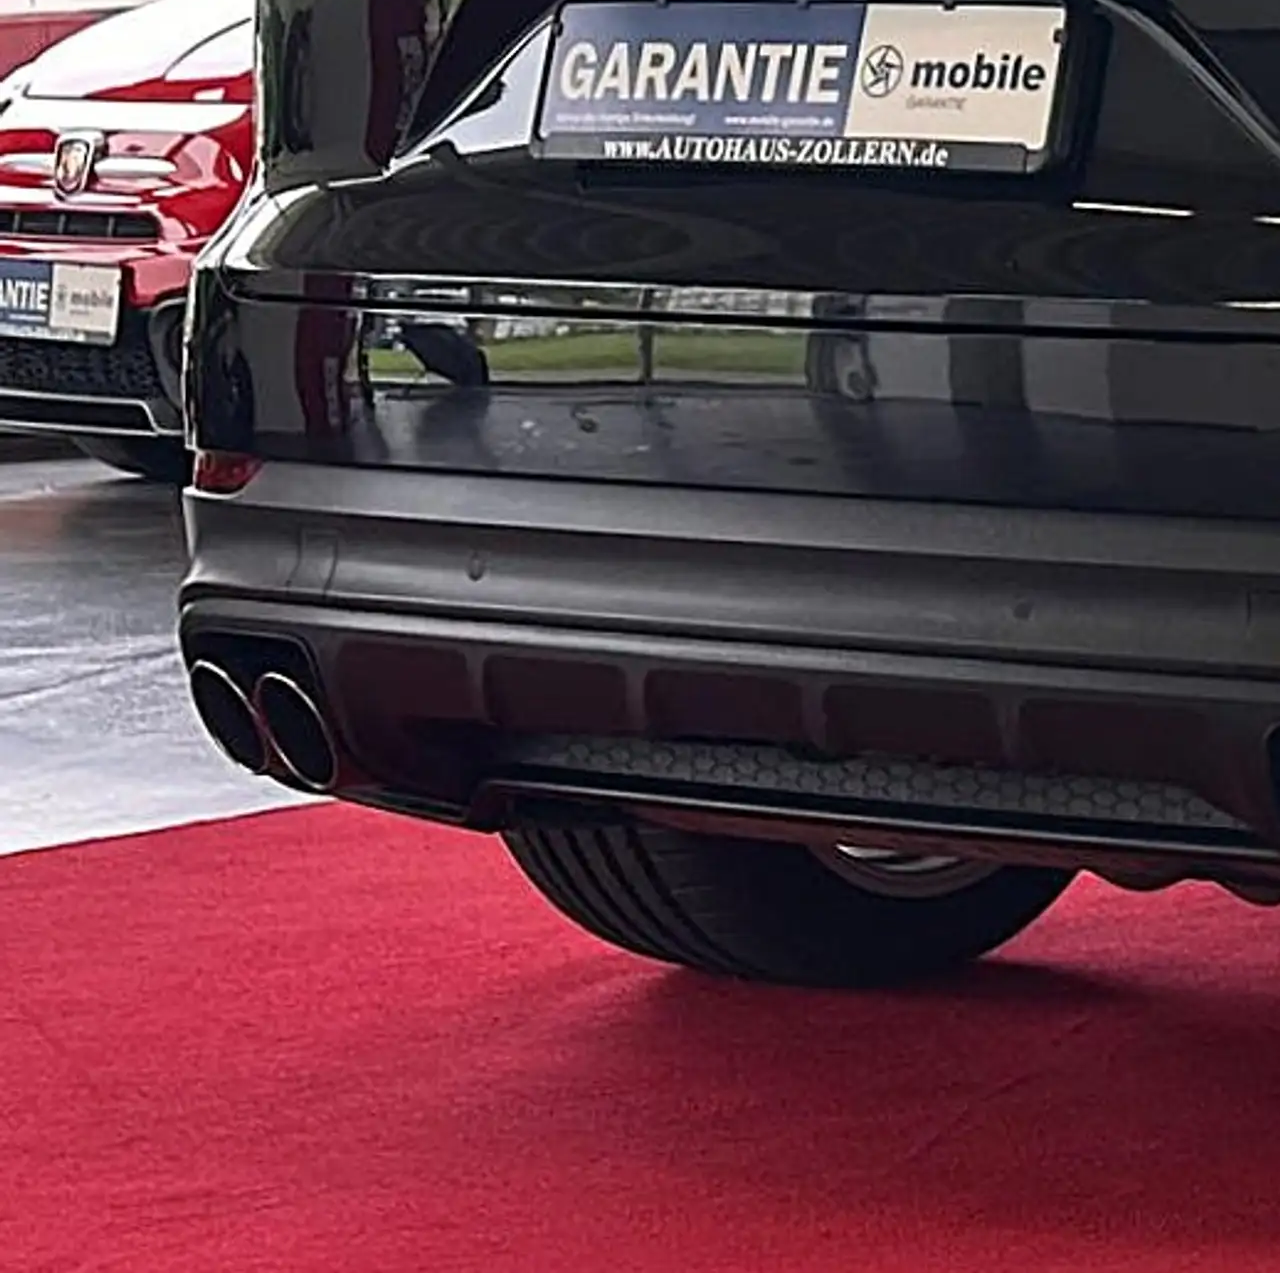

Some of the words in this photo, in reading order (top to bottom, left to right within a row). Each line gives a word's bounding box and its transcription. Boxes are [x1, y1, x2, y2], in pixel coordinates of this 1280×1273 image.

[559, 41, 848, 104] GARANTIE
[910, 52, 1047, 91] mobile
[603, 135, 949, 168] www.AUTOHAUS-ZOLLERN.de
